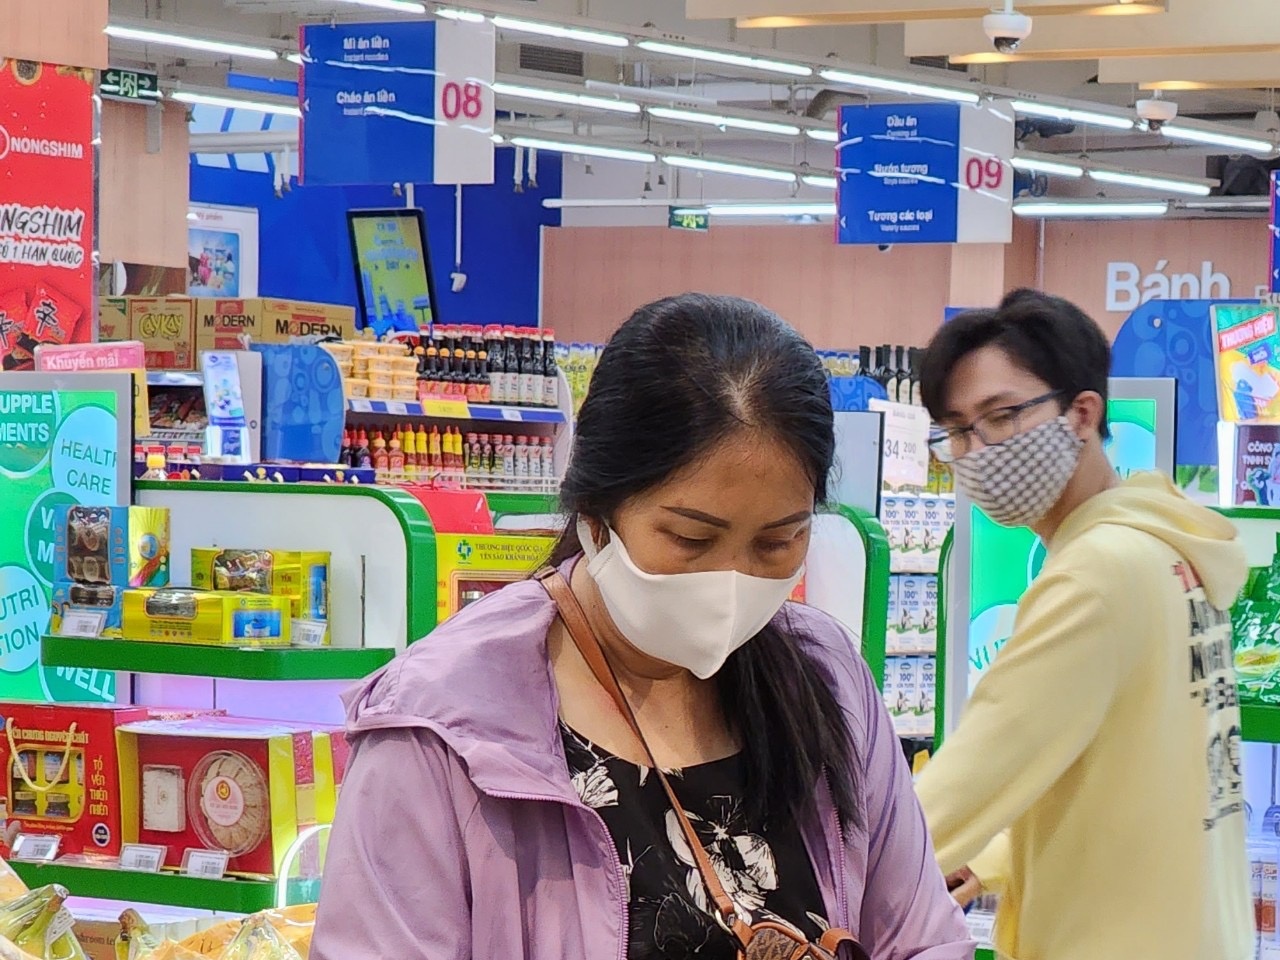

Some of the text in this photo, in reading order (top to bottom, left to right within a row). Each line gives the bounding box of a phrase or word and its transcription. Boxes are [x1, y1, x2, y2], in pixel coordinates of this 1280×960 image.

[441, 81, 482, 120] 08
[10, 136, 83, 160] NONGSHIM
[965, 156, 1004, 190] 09
[0, 208, 83, 237] NGSHIM
[867, 210, 898, 223] Tương
[1105, 259, 1232, 312] Bánh
[203, 314, 255, 328] MODERN
[275, 318, 343, 339] MODERN
[46, 352, 119, 371] Khuyến mãi
[66, 468, 112, 496] CARE
[0, 620, 39, 657] ION
